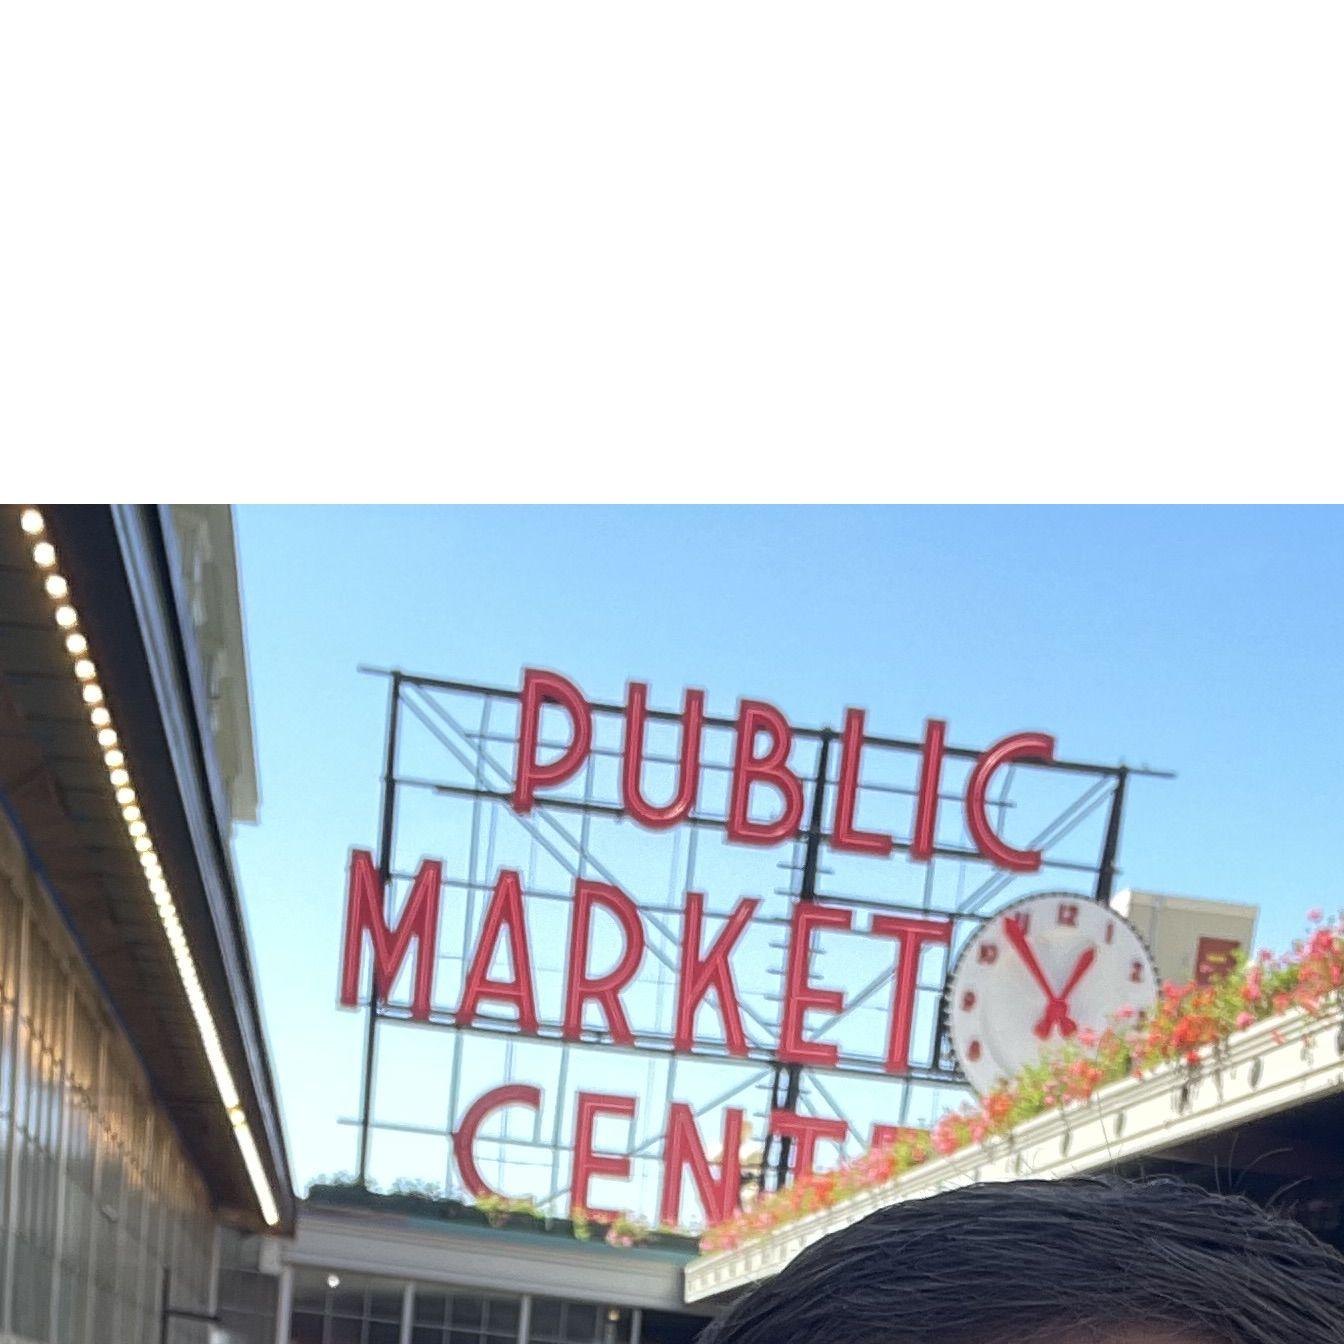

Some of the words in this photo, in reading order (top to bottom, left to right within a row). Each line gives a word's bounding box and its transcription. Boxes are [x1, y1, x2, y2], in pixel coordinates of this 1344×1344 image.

[513, 666, 1058, 872] PUBLIC
[337, 848, 952, 1076] MARKET
[453, 1083, 930, 1229] CENT
